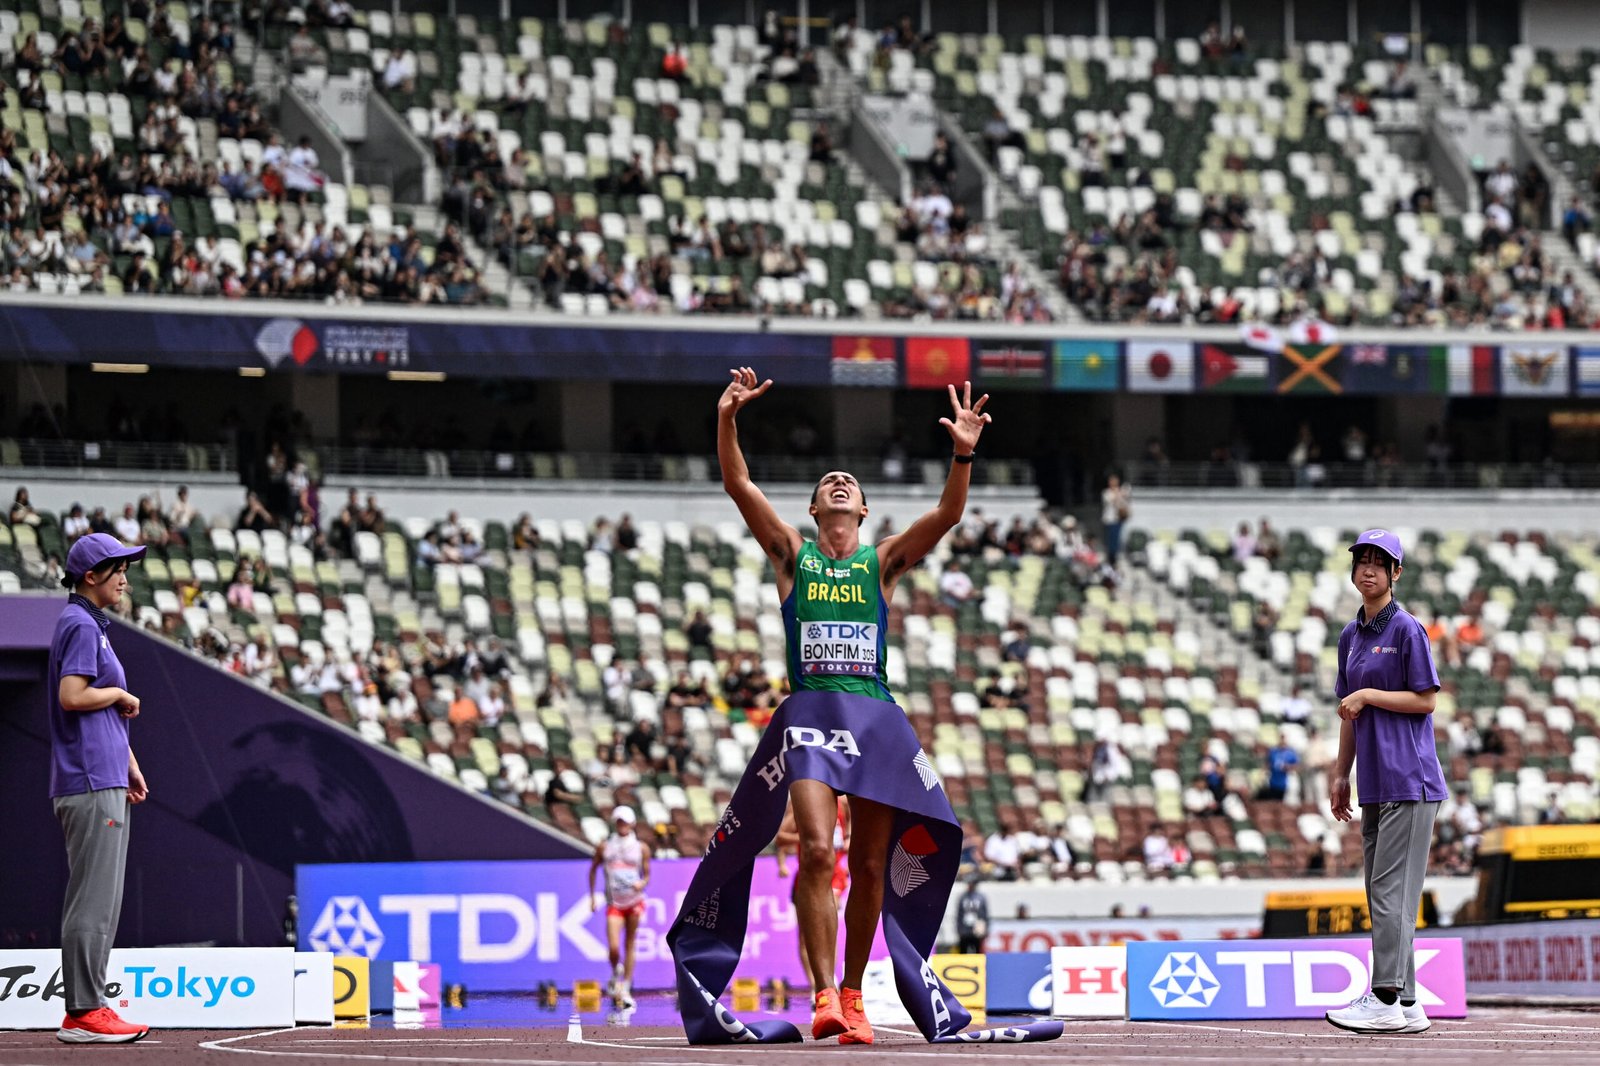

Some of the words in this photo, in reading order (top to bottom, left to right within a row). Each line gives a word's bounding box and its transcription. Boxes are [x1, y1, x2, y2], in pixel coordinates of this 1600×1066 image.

[807, 582, 867, 604] BRASIL
[822, 624, 871, 640] TDK
[804, 643, 859, 660] BONFIM
[378, 892, 609, 963] TDK
[124, 966, 256, 1007] Tokyo
